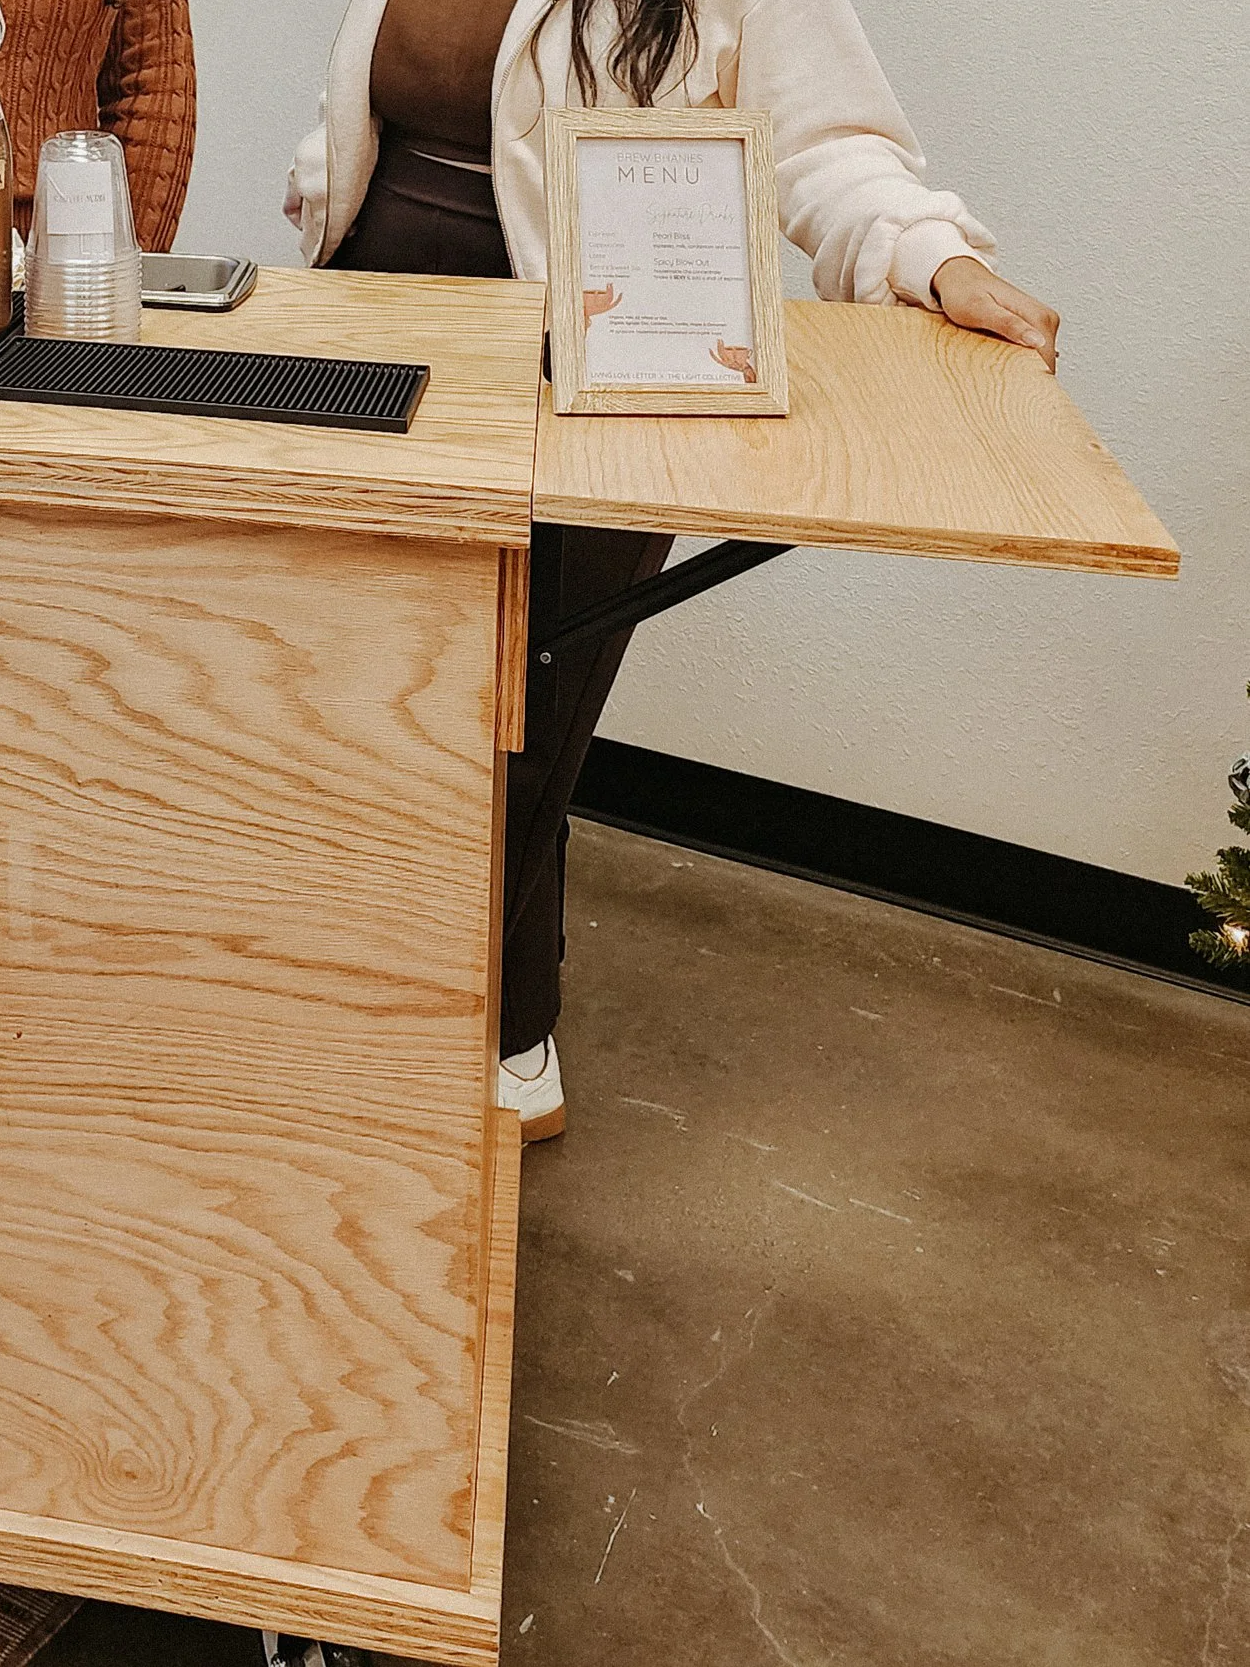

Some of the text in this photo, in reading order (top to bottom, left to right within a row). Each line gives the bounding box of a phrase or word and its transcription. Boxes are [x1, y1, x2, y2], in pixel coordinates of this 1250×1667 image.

[617, 153, 704, 164] BREW BHANIES
[618, 165, 700, 185] MENU
[652, 231, 672, 240] Pearl
[653, 257, 674, 267] Spicy
[676, 258, 694, 266] Blow
[613, 372, 631, 380] LOVE
[668, 373, 680, 381] THE
[682, 373, 700, 381] LIGHT
[702, 374, 742, 382] COLLECTIVE
